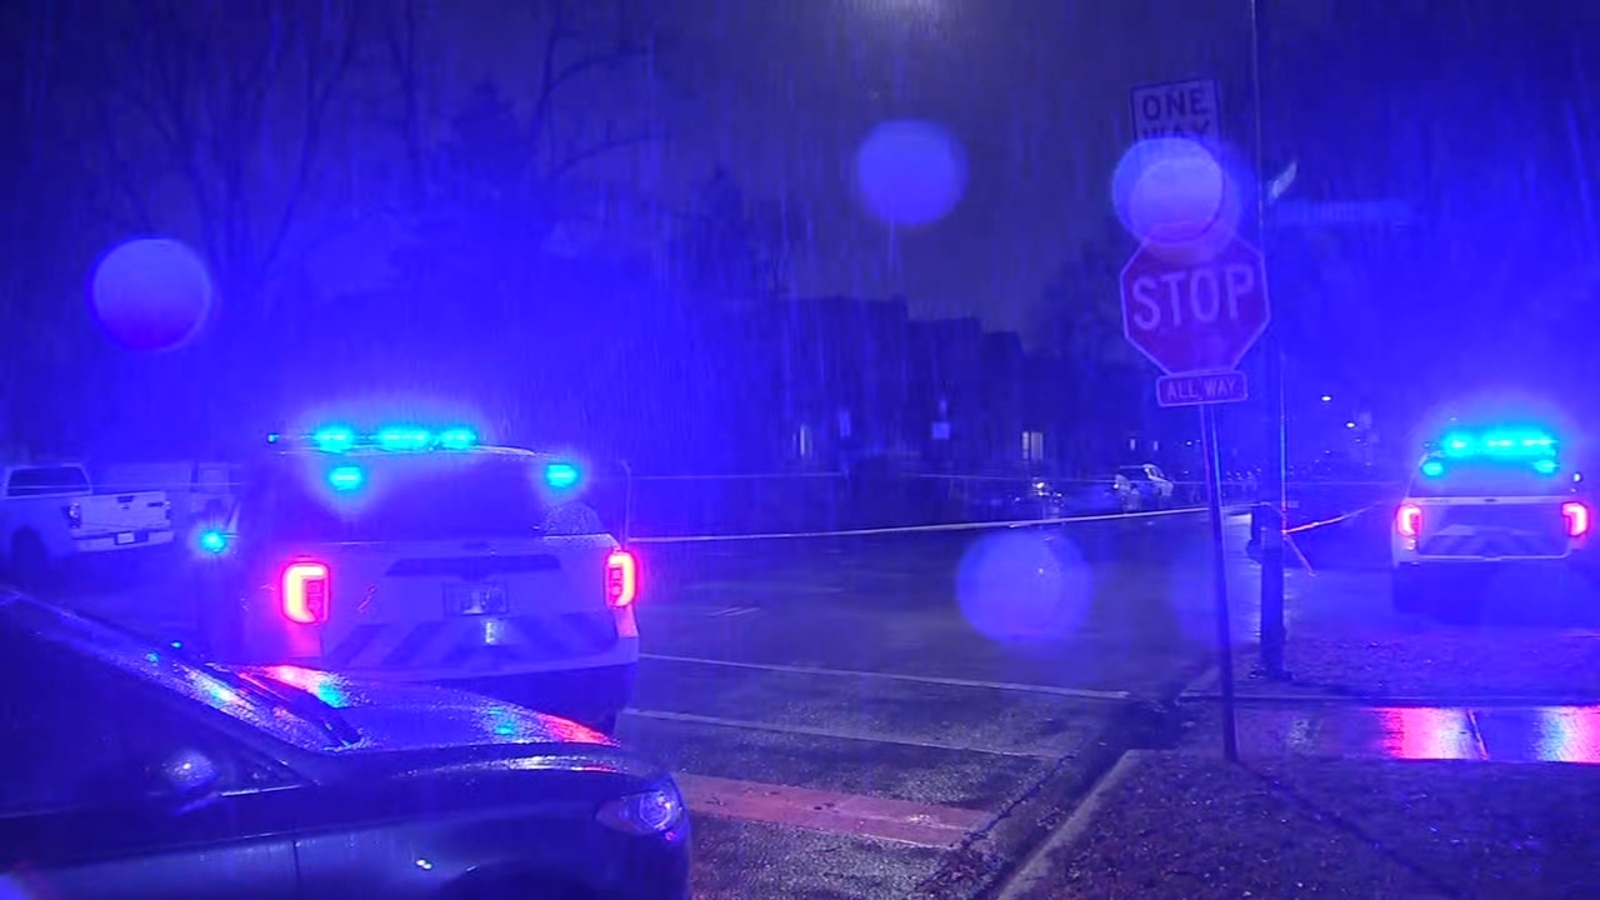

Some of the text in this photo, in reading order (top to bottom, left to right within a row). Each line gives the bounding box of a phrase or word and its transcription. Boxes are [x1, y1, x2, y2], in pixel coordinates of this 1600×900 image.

[1142, 88, 1209, 121] ONE
[1132, 263, 1254, 331] STOP
[1167, 377, 1236, 400] ALL WAY
